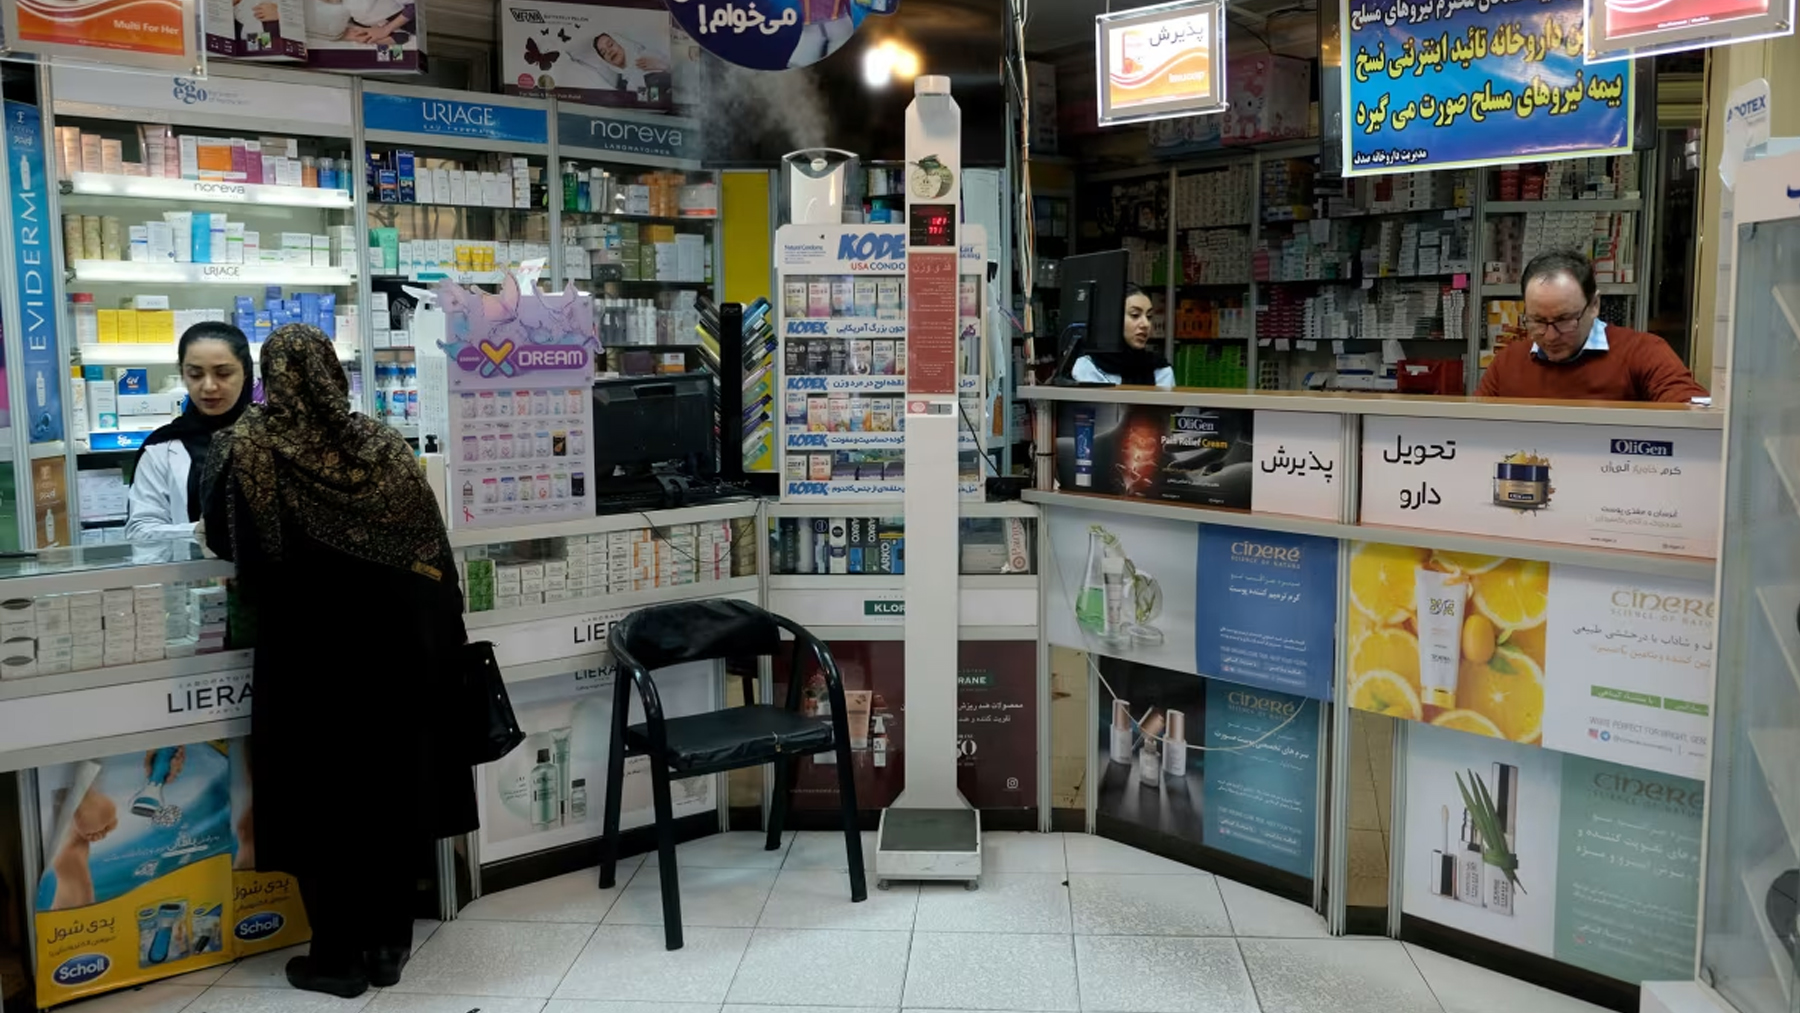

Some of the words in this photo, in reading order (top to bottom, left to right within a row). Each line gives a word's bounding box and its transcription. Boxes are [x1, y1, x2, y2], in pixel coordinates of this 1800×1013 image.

[113, 20, 141, 31] Multi
[143, 23, 159, 32] For
[161, 25, 179, 35] Her
[1351, 3, 1382, 30] مسلح
[1149, 21, 1204, 47] پذیرش
[1490, 15, 1563, 62] داروخانه
[1356, 43, 1385, 81] نسخ
[1388, 32, 1448, 79] اینترنتی
[1471, 81, 1512, 121] مسلح
[1516, 70, 1583, 117] نیروهای
[1588, 75, 1622, 107] بیمه
[421, 101, 493, 127] URIAGE
[1356, 93, 1390, 133] گیرد
[1391, 101, 1417, 130] می
[1420, 94, 1468, 126] صورت
[590, 120, 683, 147] noreva
[194, 183, 245, 194] noreva
[837, 232, 905, 261] KODE
[19, 192, 47, 350] EVIDERM
[203, 266, 240, 277] URIAGE
[851, 262, 869, 271] USA
[869, 262, 905, 271] CONDO
[787, 321, 828, 335] KODEX
[518, 350, 583, 366] DREAM
[787, 377, 828, 391] KODEX
[788, 434, 829, 448] KODEX
[1161, 436, 1178, 445] Pain
[1202, 438, 1228, 448] Cream
[1383, 434, 1456, 465] تحویل
[1615, 440, 1667, 456] OliGen
[1261, 445, 1333, 484] پذیرش
[788, 482, 829, 497] KODEX
[1400, 481, 1442, 510] دارو
[880, 542, 891, 572] ARKO
[874, 603, 905, 613] KLOR
[179, 674, 251, 688] LABORATOIR
[575, 664, 617, 680] LIERA
[957, 676, 987, 684] RANE
[167, 682, 254, 714] LIERA
[47, 920, 85, 945] شول
[239, 917, 280, 936] Scholl
[59, 958, 105, 980] Scholl
